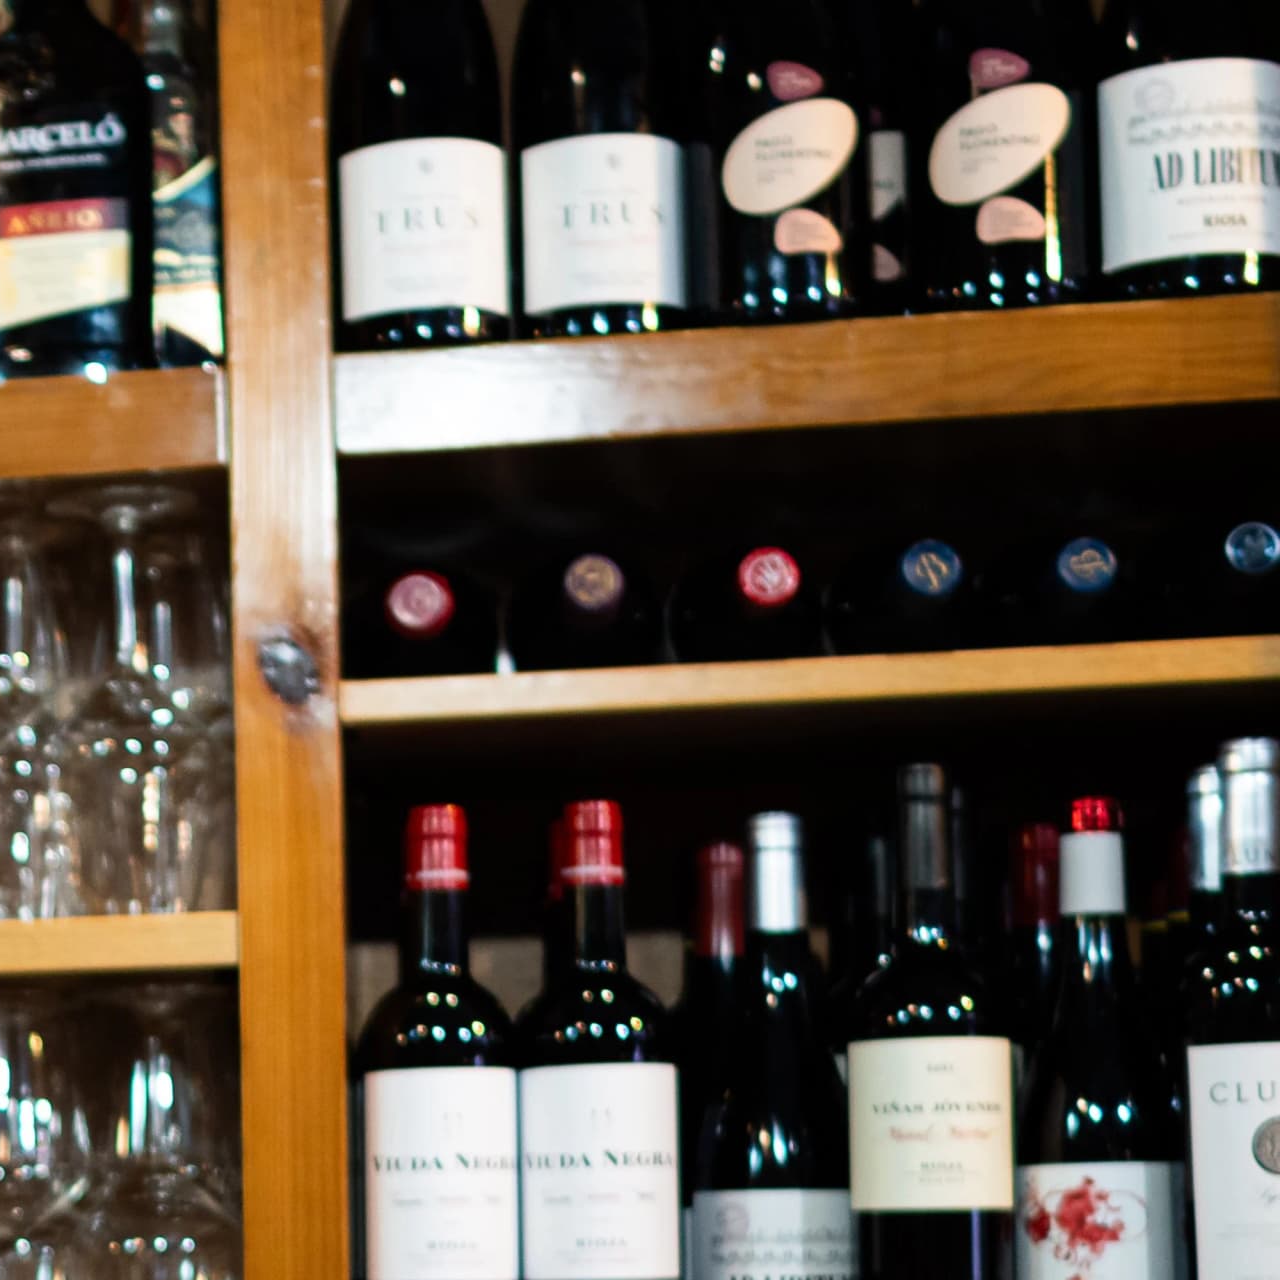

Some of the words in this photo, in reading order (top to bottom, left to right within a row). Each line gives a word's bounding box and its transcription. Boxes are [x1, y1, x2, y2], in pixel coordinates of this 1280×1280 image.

[1149, 151, 1185, 191] AD
[374, 205, 481, 234] TRUS
[561, 201, 667, 230] TRUS
[373, 1153, 444, 1172] VIUDA
